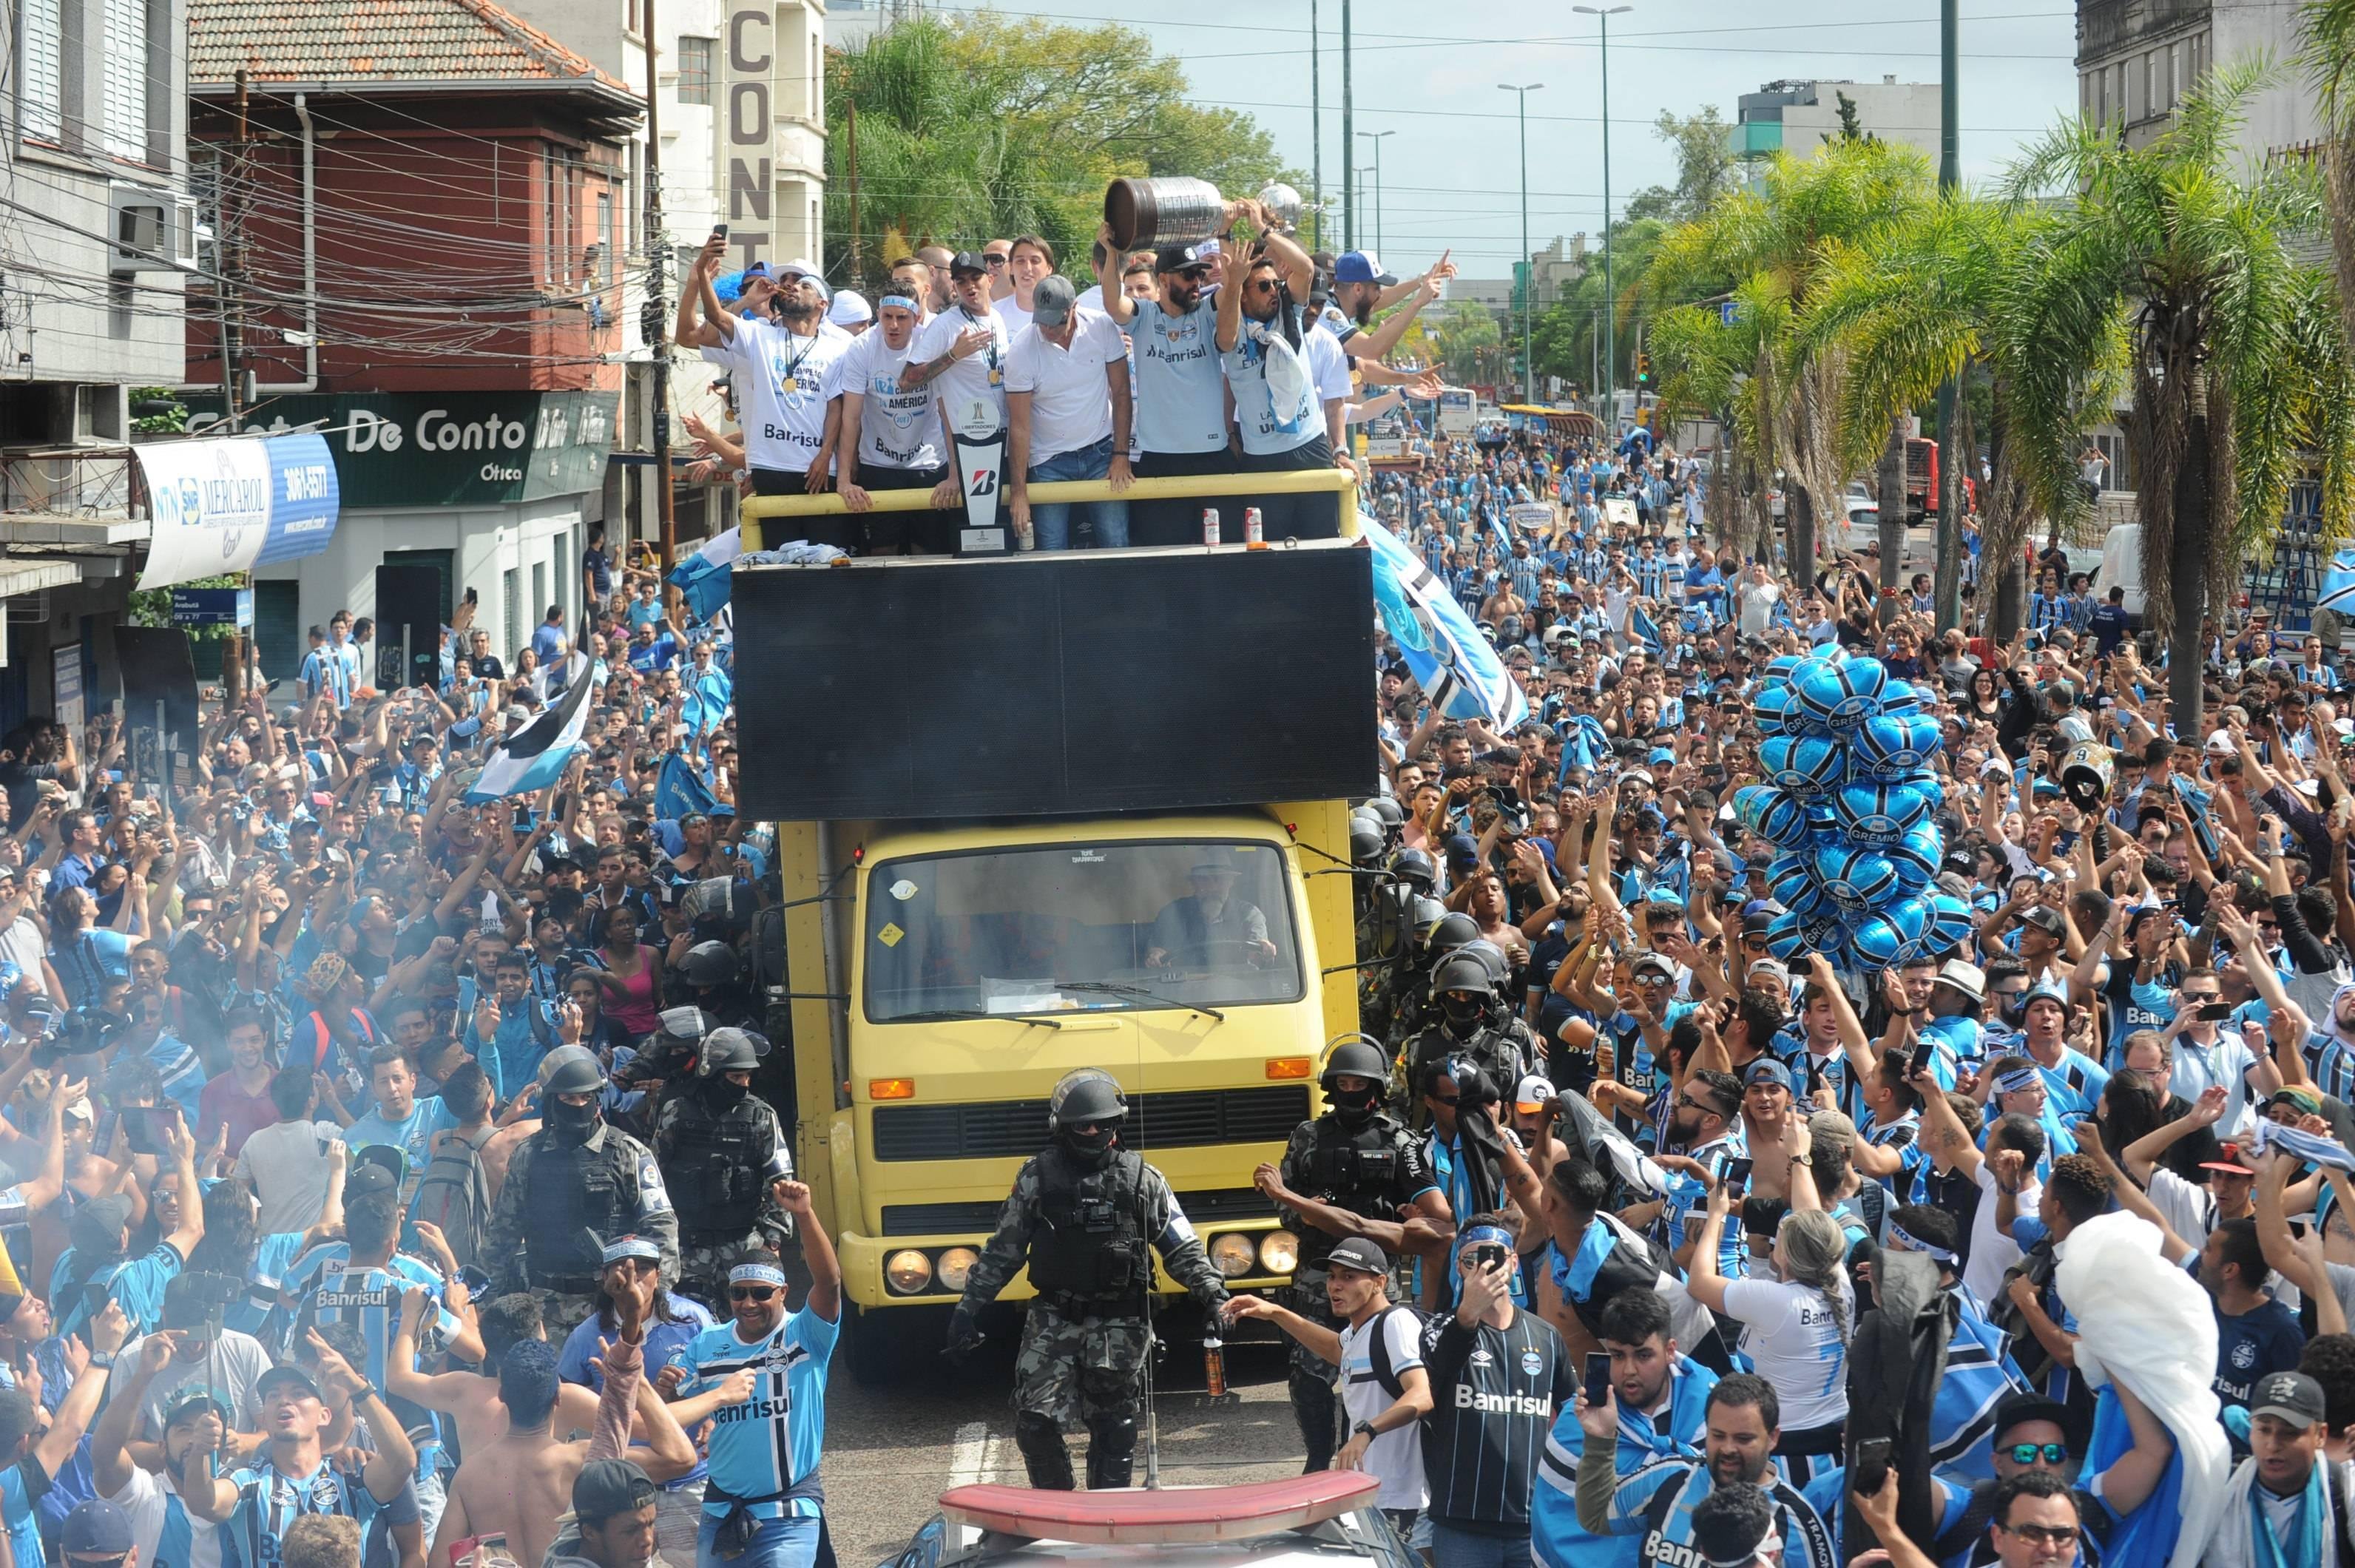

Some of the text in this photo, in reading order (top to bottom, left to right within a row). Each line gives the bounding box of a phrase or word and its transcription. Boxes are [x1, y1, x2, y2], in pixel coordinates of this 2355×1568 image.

[888, 393, 928, 410] AMÉRICA
[347, 409, 403, 453] De
[416, 410, 526, 452] Conto
[481, 462, 522, 481] Ótica
[203, 479, 264, 516] MERCAROL
[2076, 749, 2087, 761] 9
[1852, 828, 1899, 842] GRÊMIO
[317, 1286, 388, 1307] Banrisul
[712, 1385, 794, 1425] anrisul
[1455, 1384, 1552, 1419] Banrisul
